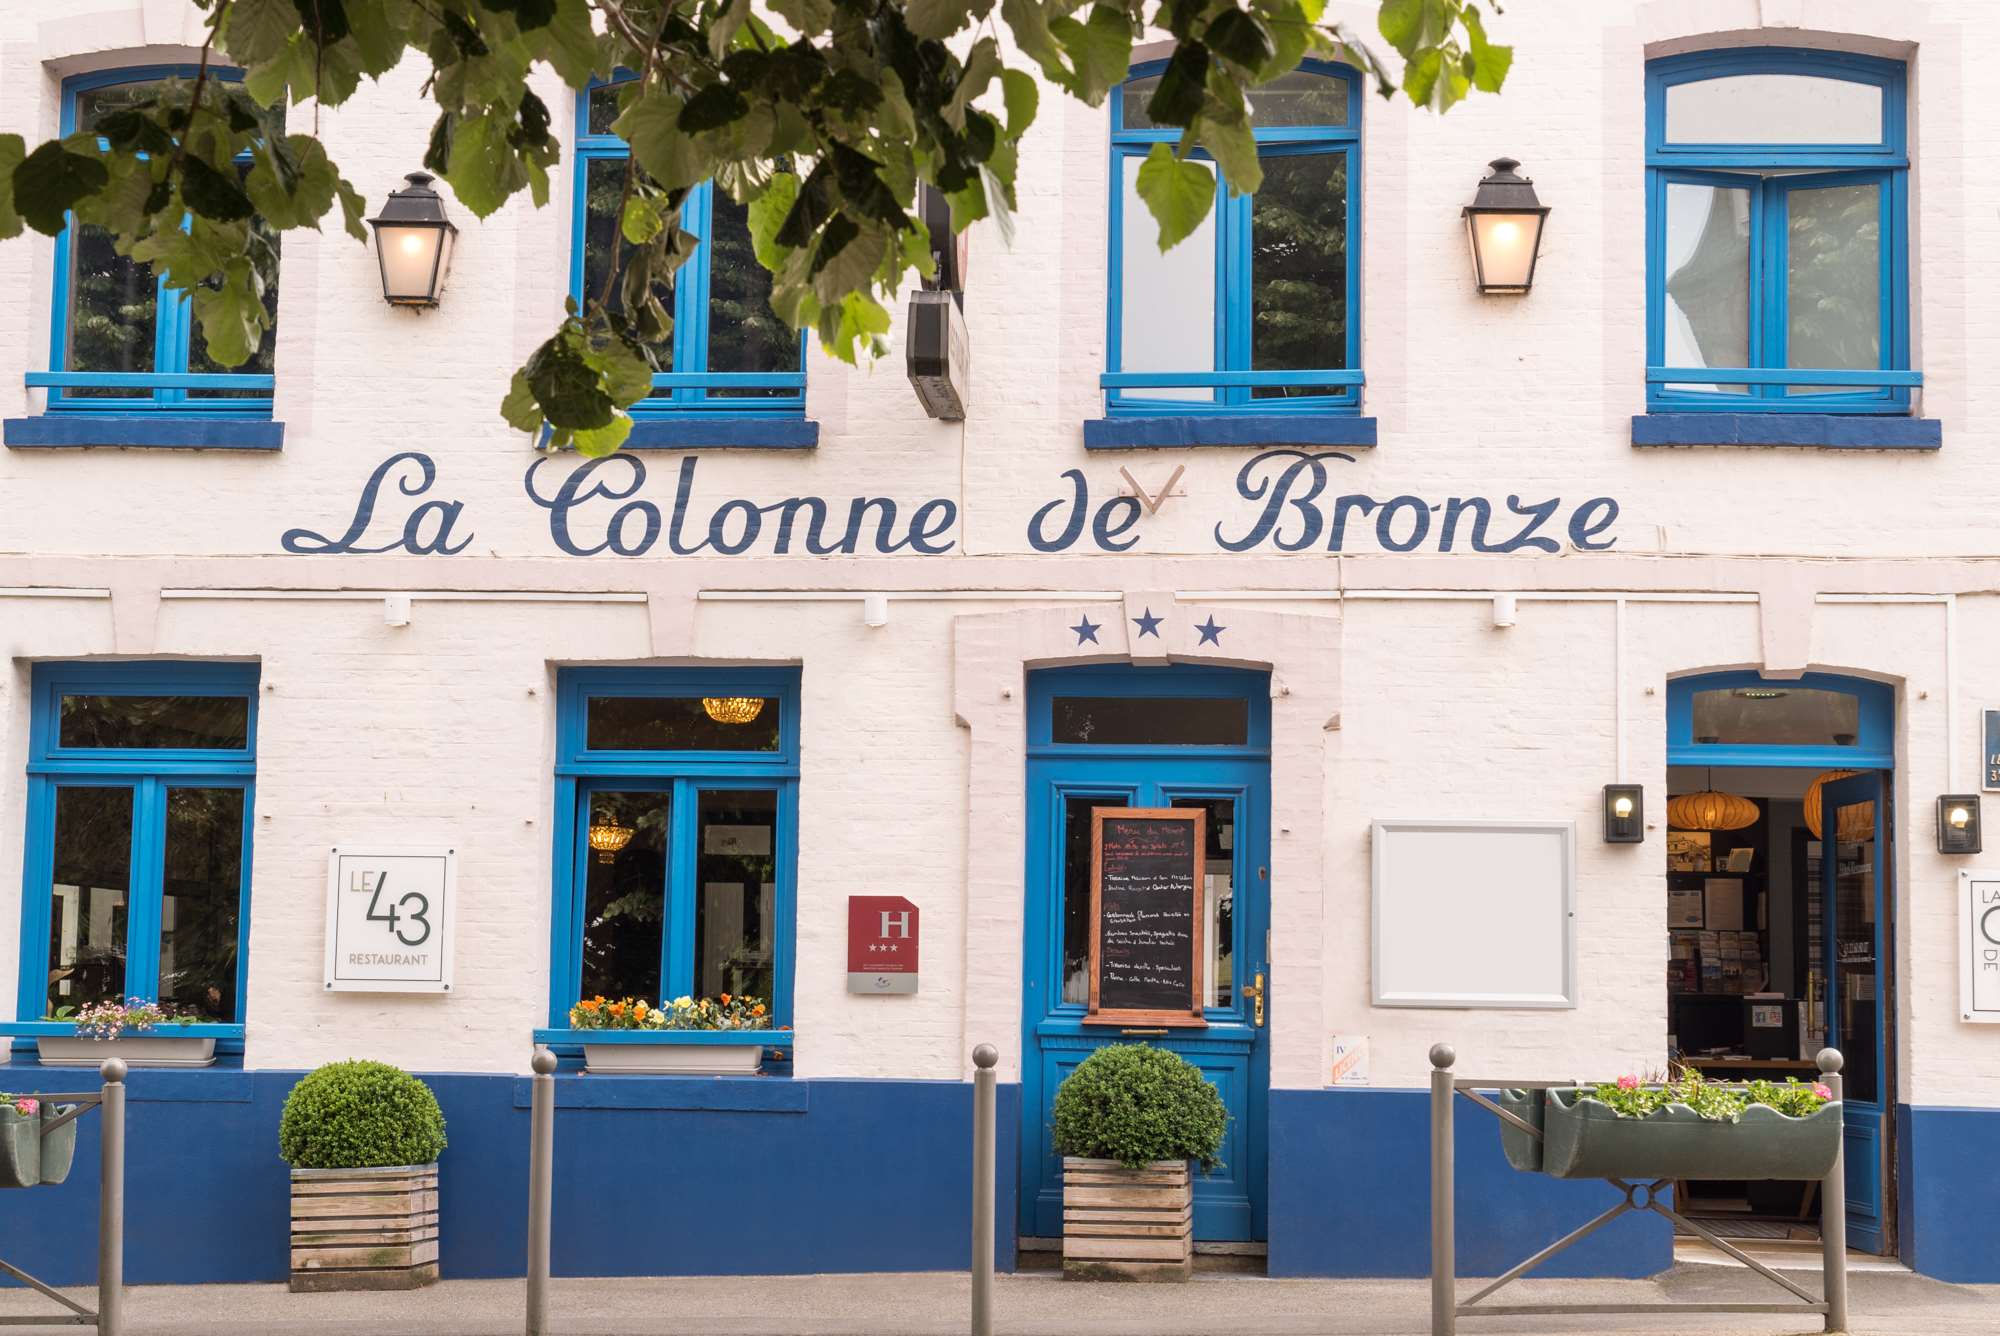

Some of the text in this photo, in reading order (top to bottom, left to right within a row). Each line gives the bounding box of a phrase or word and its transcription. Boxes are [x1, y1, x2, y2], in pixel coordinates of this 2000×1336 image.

[281, 449, 1620, 556] La Colonne de Bronze
[351, 871, 431, 946] LE 43
[879, 911, 912, 939] H
[349, 953, 428, 966] RESTAURANT
